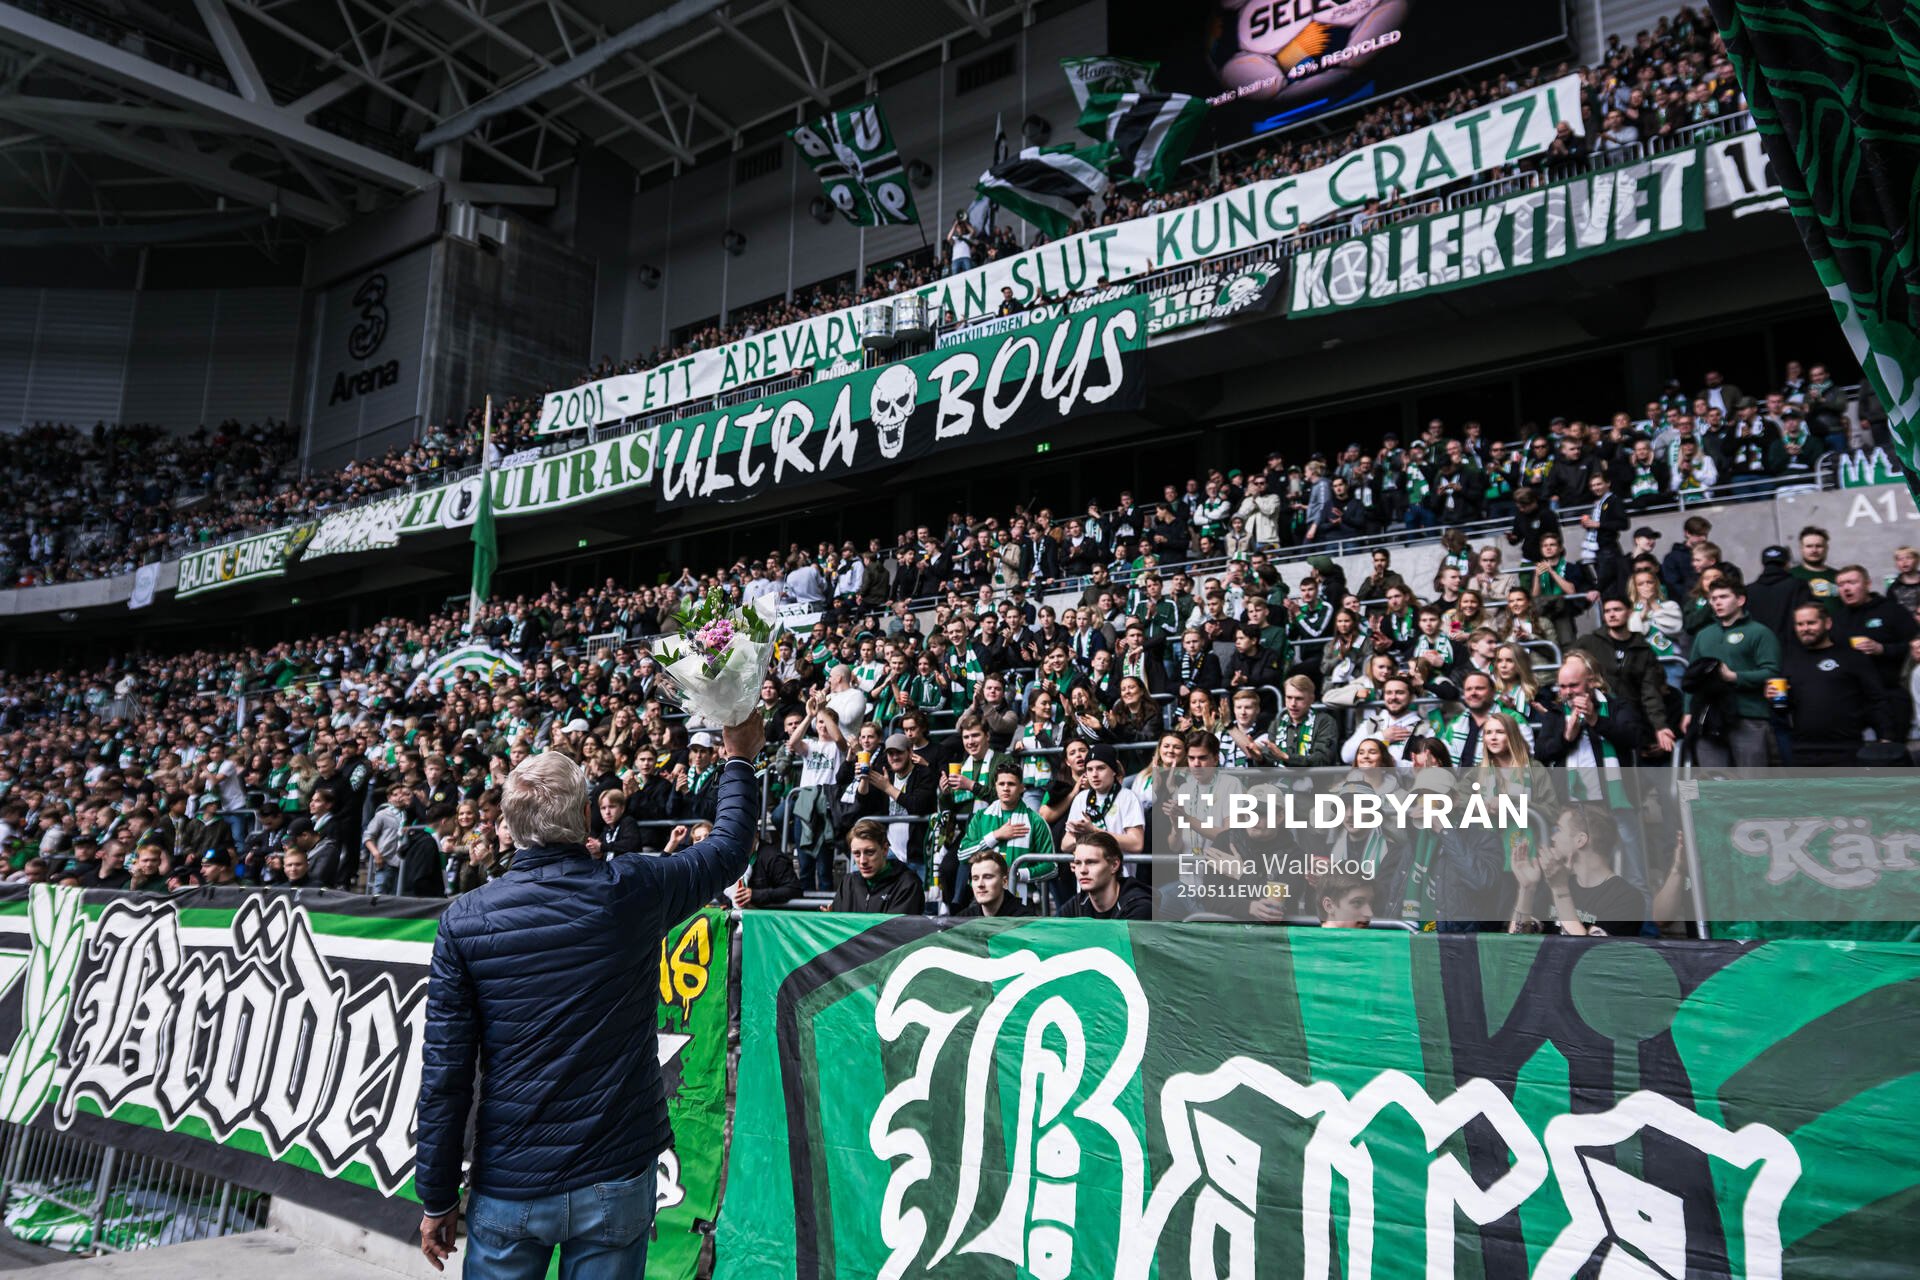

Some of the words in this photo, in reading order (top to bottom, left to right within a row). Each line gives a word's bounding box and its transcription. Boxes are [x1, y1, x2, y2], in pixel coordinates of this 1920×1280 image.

[1320, 29, 1401, 68] RECYCLED
[1293, 149, 1698, 312] KOLLEKTIVET
[548, 384, 604, 431] 2001
[644, 359, 695, 410] ETT
[1157, 179, 1298, 267] KUNG
[1148, 303, 1212, 333] SOFIA
[1149, 285, 1216, 316] 116
[328, 359, 399, 406] Arena
[662, 384, 858, 501] ULTRA
[928, 307, 1138, 441] BOYS
[491, 433, 653, 511] ULTRAS
[178, 549, 224, 592] BAJEN
[235, 536, 277, 576] FANS
